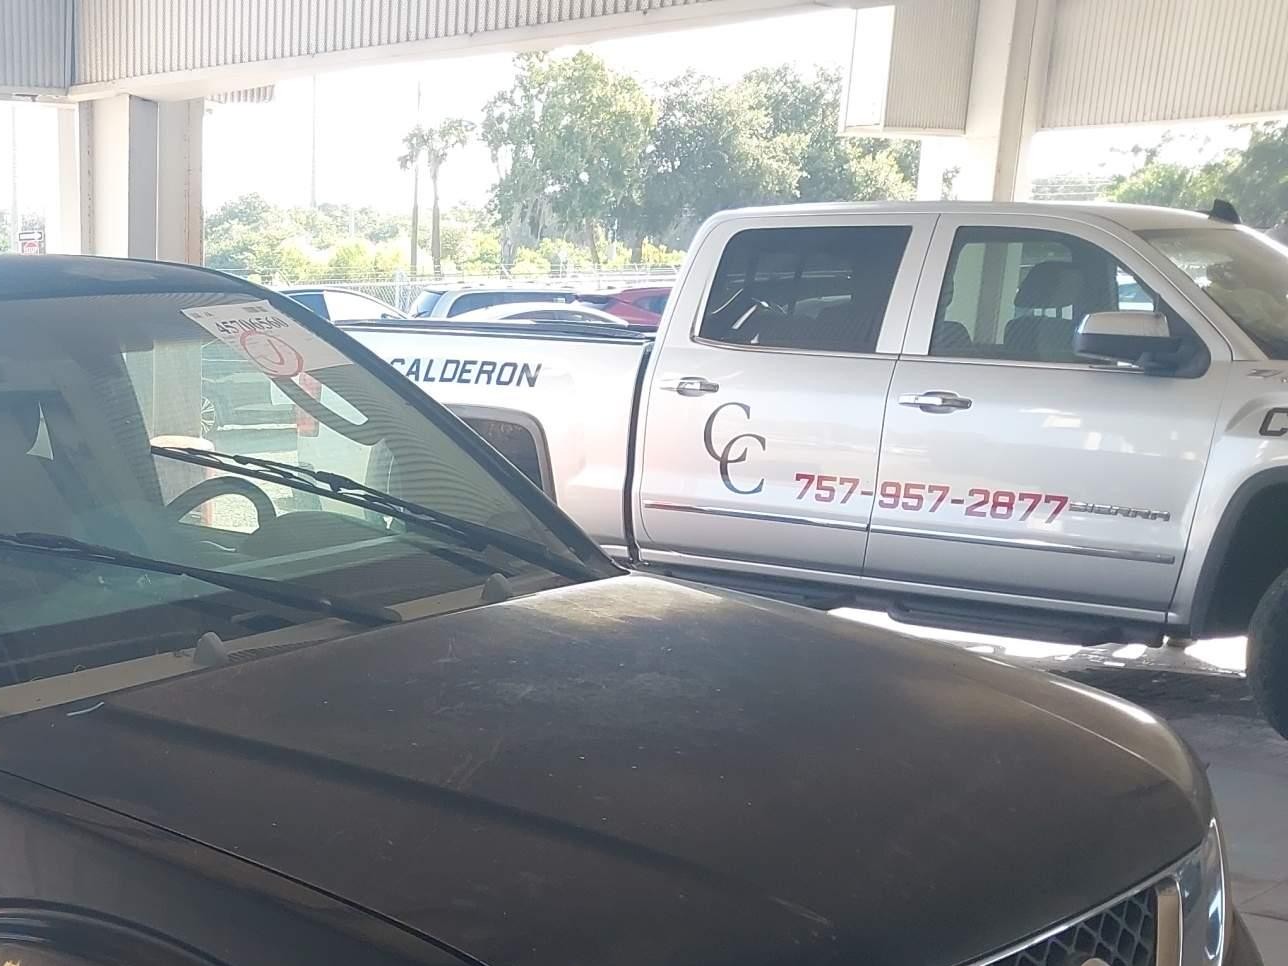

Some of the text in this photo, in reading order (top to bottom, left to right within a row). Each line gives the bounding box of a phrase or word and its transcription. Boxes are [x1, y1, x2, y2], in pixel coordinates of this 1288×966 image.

[215, 316, 289, 335] 45706560
[794, 473, 1070, 525] 757-957-2877
[1069, 501, 1171, 522] SIERRA
